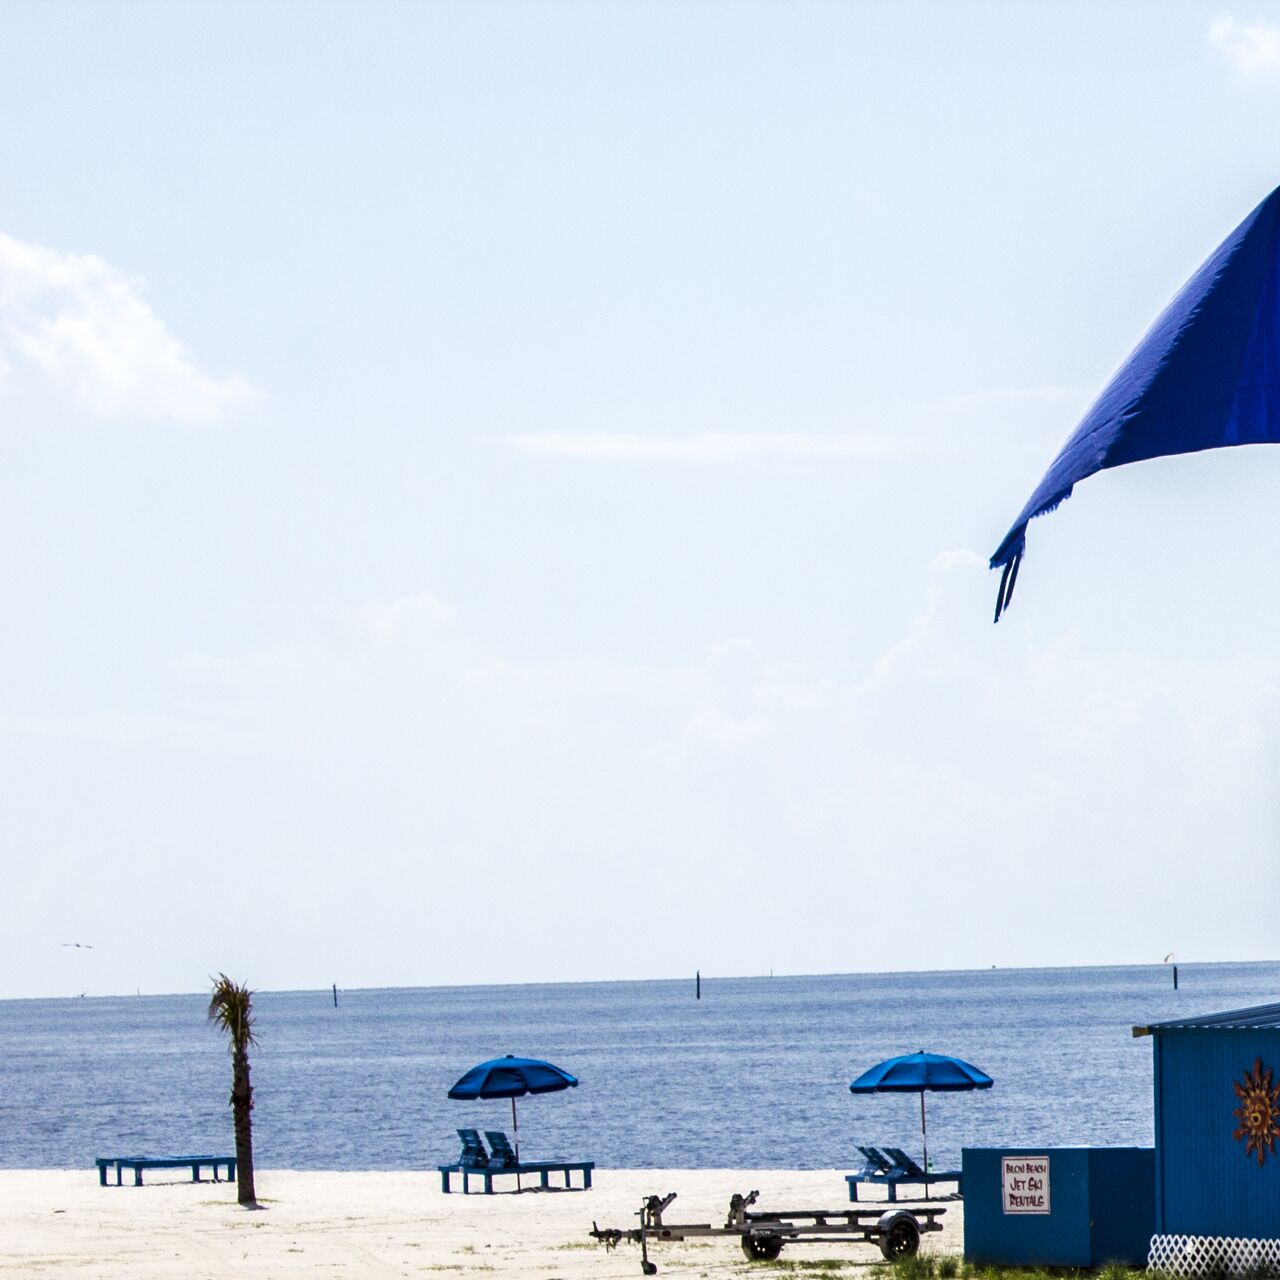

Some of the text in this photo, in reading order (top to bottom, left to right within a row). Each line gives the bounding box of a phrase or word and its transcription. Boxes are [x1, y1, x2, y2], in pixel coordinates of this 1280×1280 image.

[1026, 1163, 1047, 1174] BEACH
[1010, 1177, 1043, 1191] JET SKI
[1009, 1193, 1044, 1207] RENTALS
